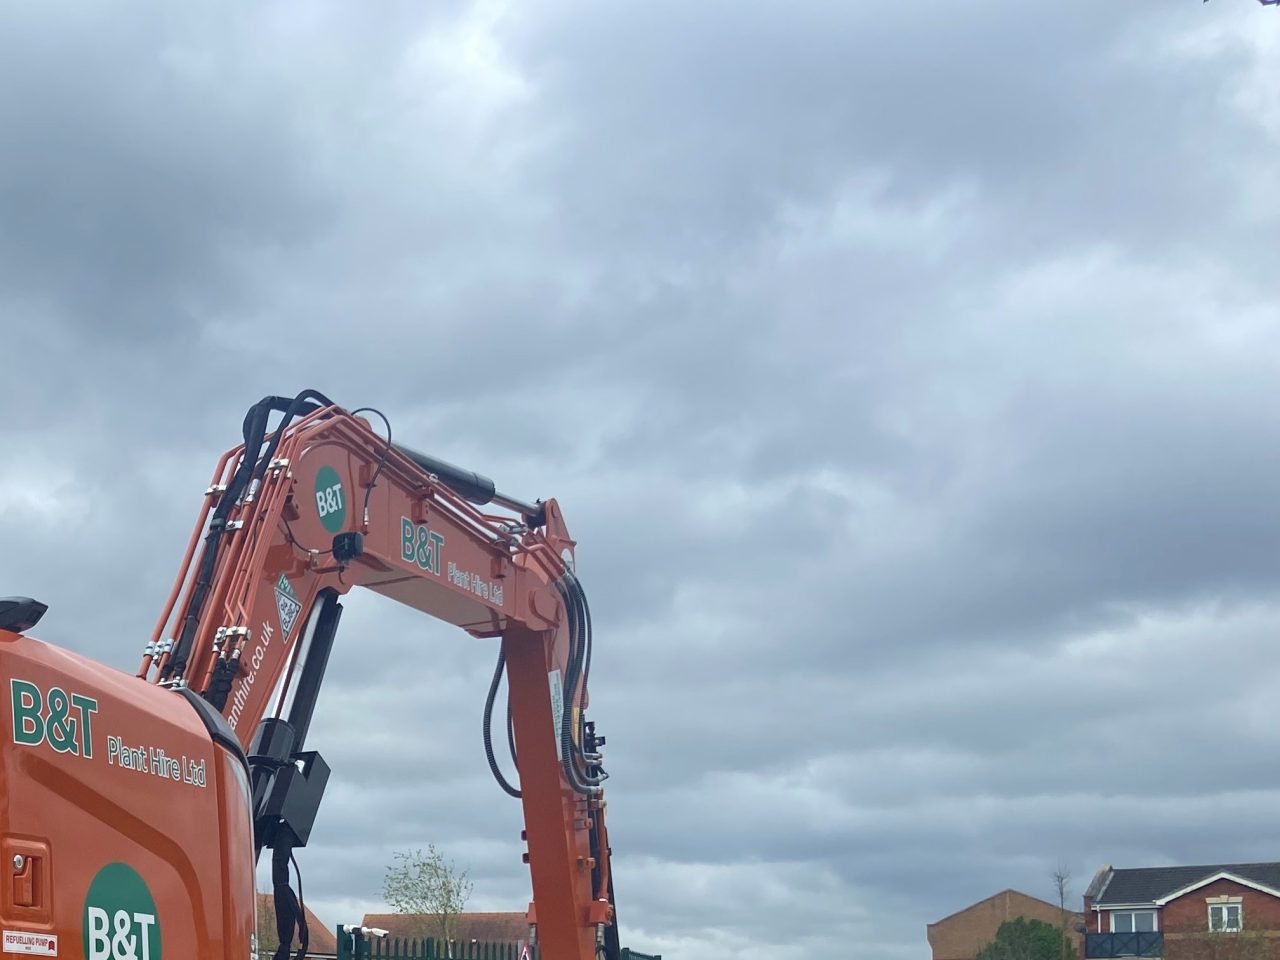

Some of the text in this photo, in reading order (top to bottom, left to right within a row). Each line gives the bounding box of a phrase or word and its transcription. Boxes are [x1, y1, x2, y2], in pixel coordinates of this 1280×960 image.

[316, 483, 342, 517] B&T
[400, 515, 503, 607] B&T Plant Hire Ltd
[227, 620, 274, 730] anthire.co.uk
[10, 678, 207, 788] B&T Plant Hire Ltd
[5, 935, 48, 947] REFUELLING PUMP
